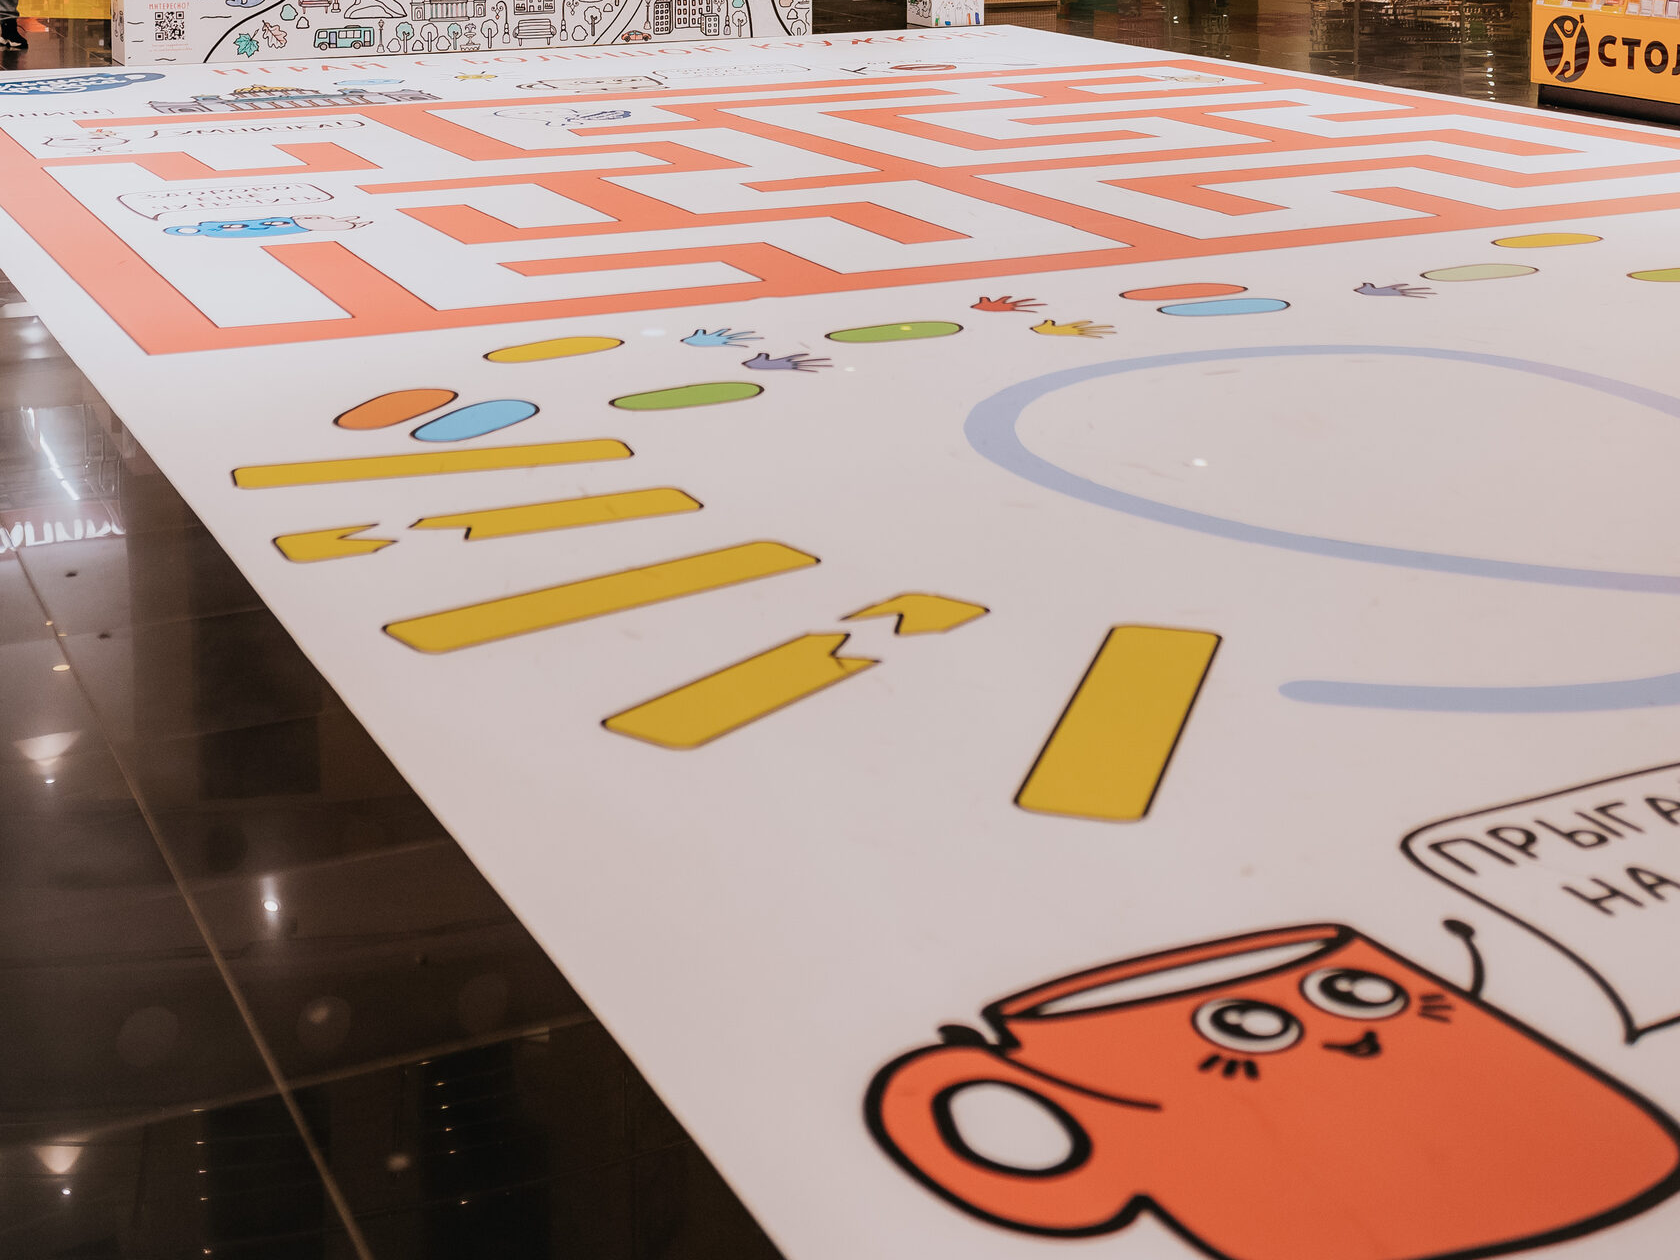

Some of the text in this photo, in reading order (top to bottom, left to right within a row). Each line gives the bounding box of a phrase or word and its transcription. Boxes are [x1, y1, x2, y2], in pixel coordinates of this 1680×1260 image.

[212, 61, 388, 76] ИГРАЙ
[461, 44, 732, 65] БОЛЬШОЙ
[751, 30, 1010, 51] КРУЖКОЙ!
[1428, 778, 1680, 876] ПРЫГА
[1561, 866, 1680, 916] НА
